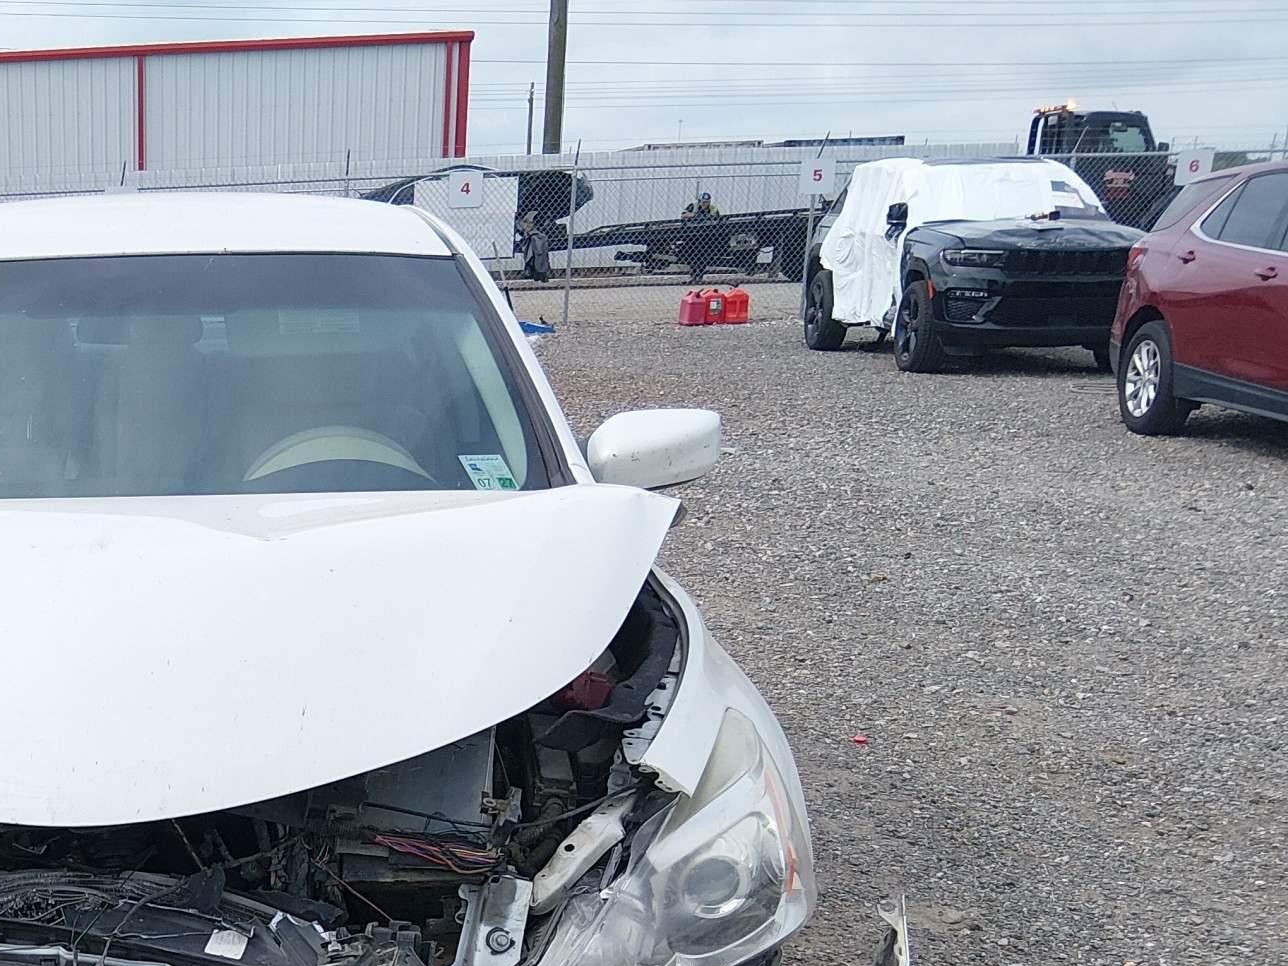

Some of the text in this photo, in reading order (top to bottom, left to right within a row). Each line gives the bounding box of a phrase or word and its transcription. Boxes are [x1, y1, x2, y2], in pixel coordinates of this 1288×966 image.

[1189, 160, 1200, 173] 6
[812, 169, 823, 182] 5
[460, 182, 471, 195] 4
[478, 478, 516, 488] 07 27
